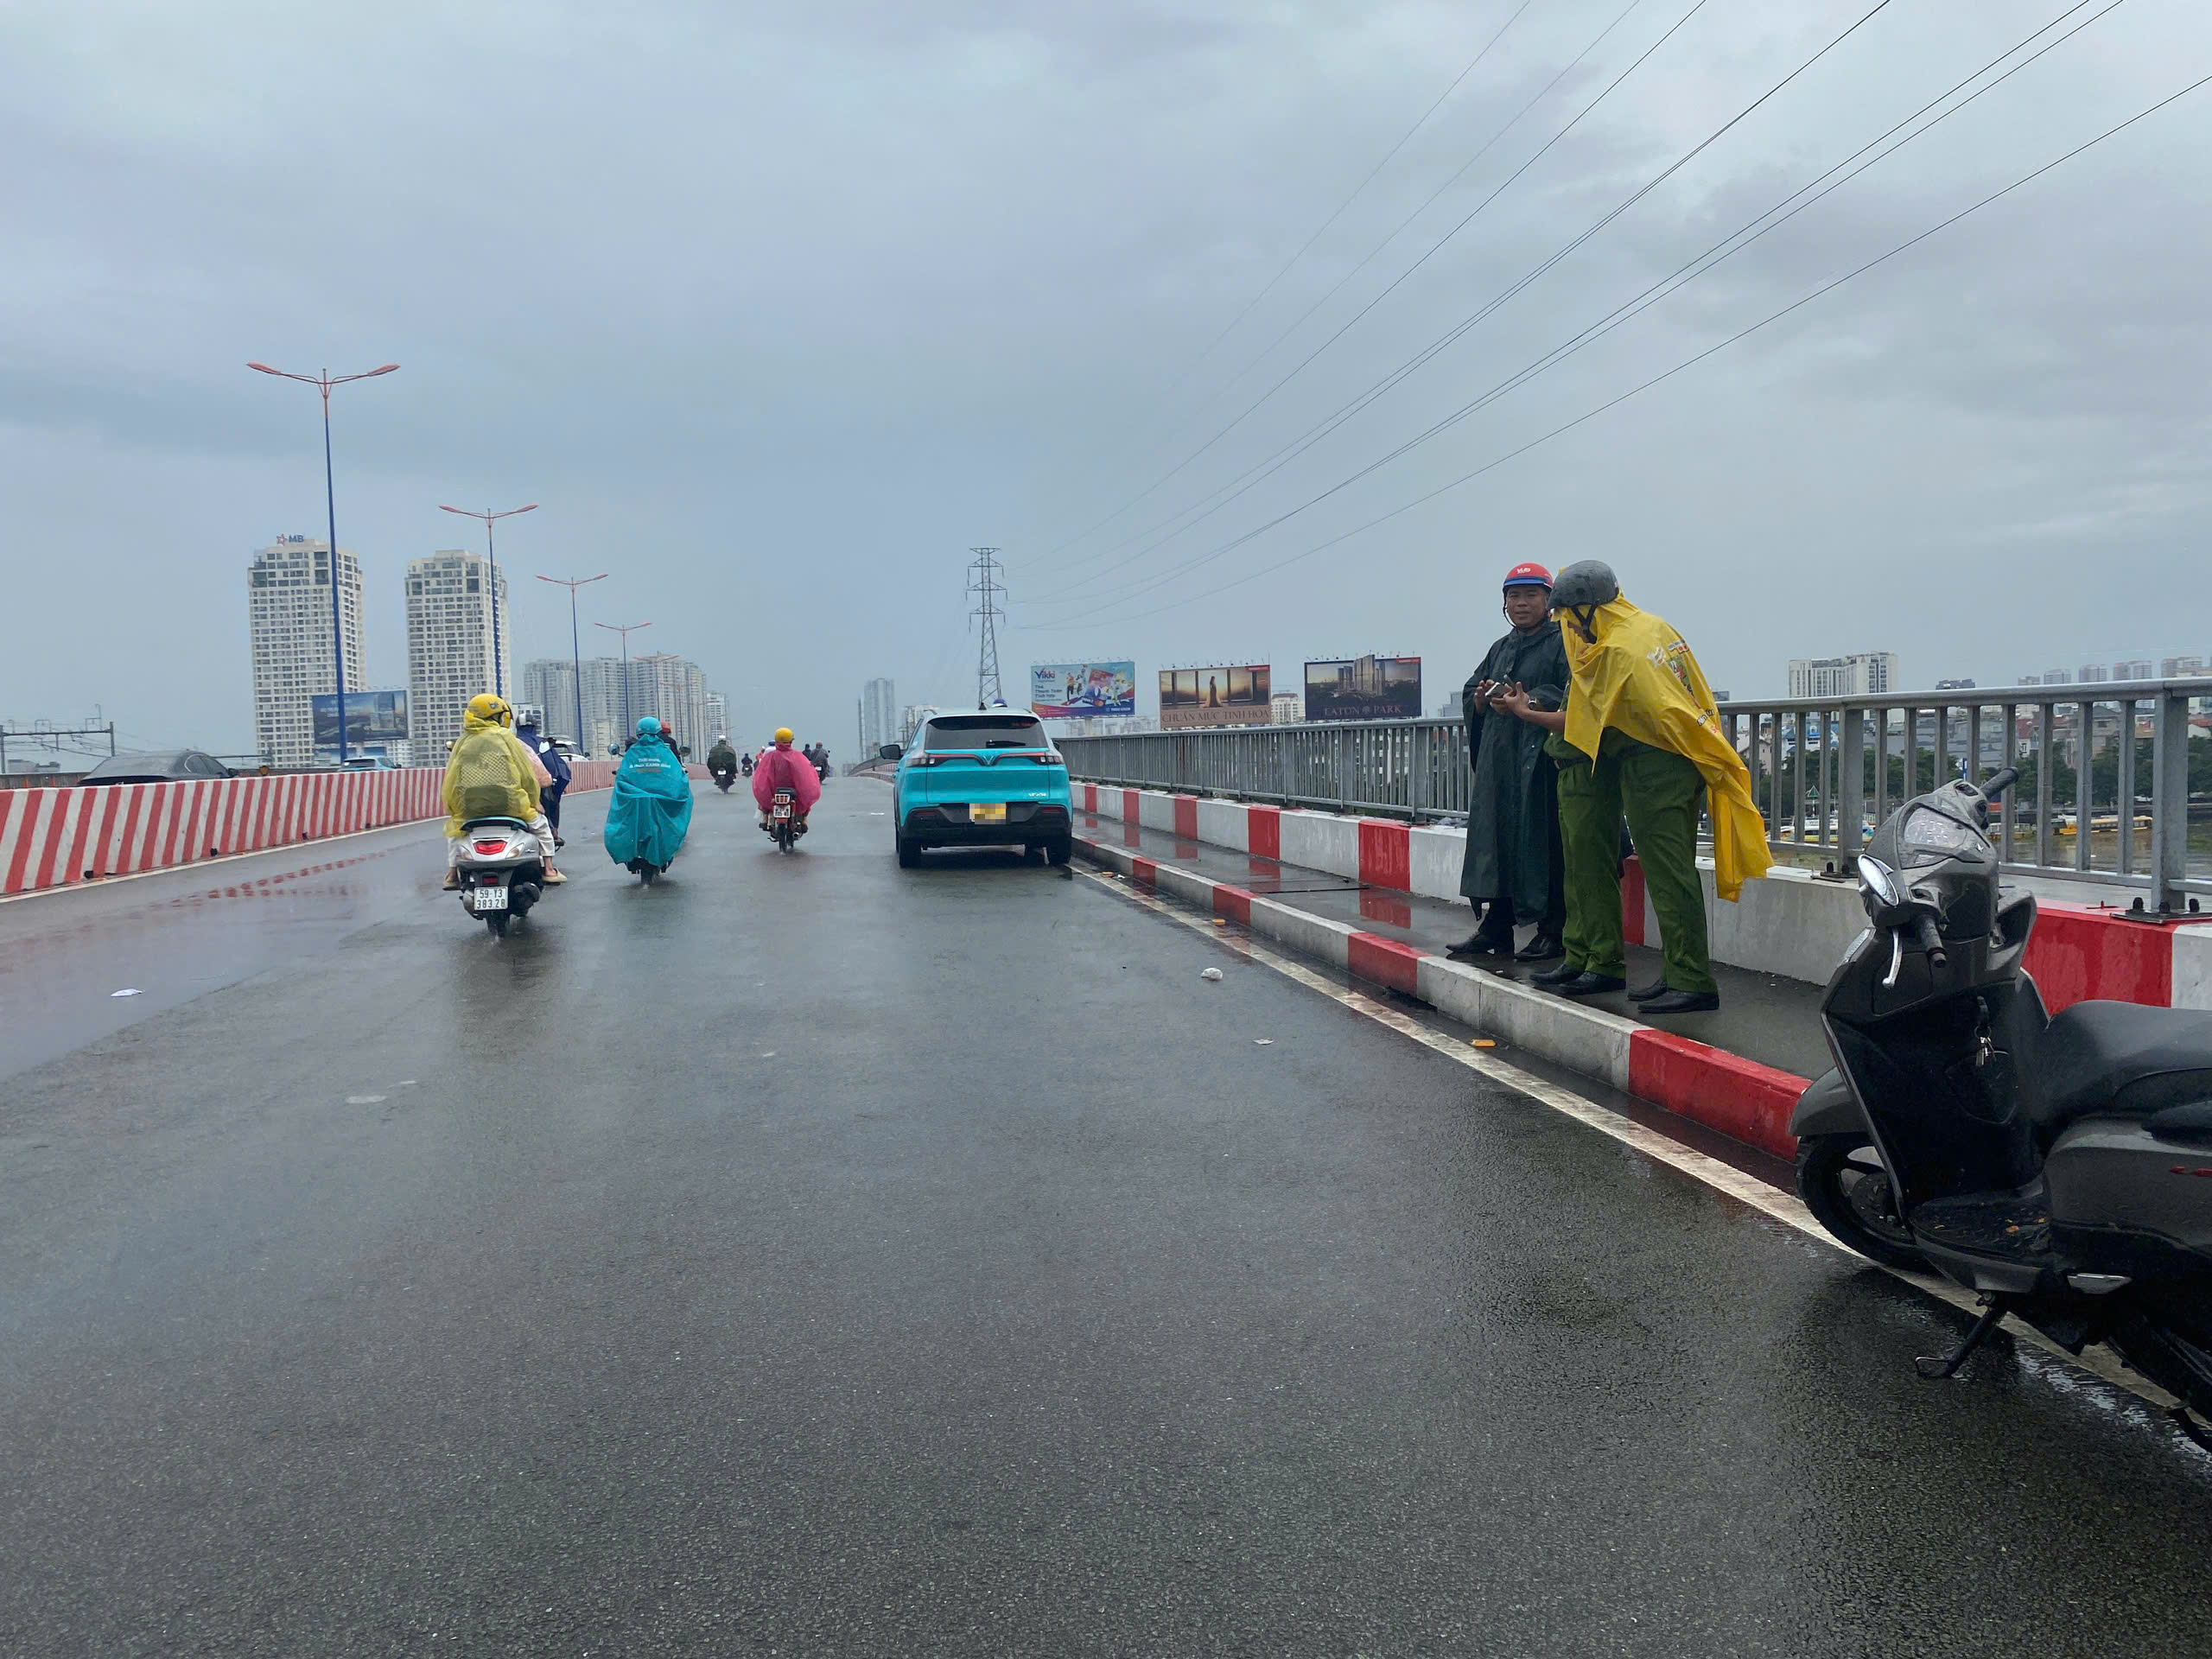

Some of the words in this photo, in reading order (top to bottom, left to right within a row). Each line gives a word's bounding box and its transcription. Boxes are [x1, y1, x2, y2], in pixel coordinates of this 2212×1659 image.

[288, 534, 304, 543] MB
[1034, 667, 1056, 679] Vikki
[1324, 706, 1360, 716] EATON
[1373, 704, 1402, 715] PARK
